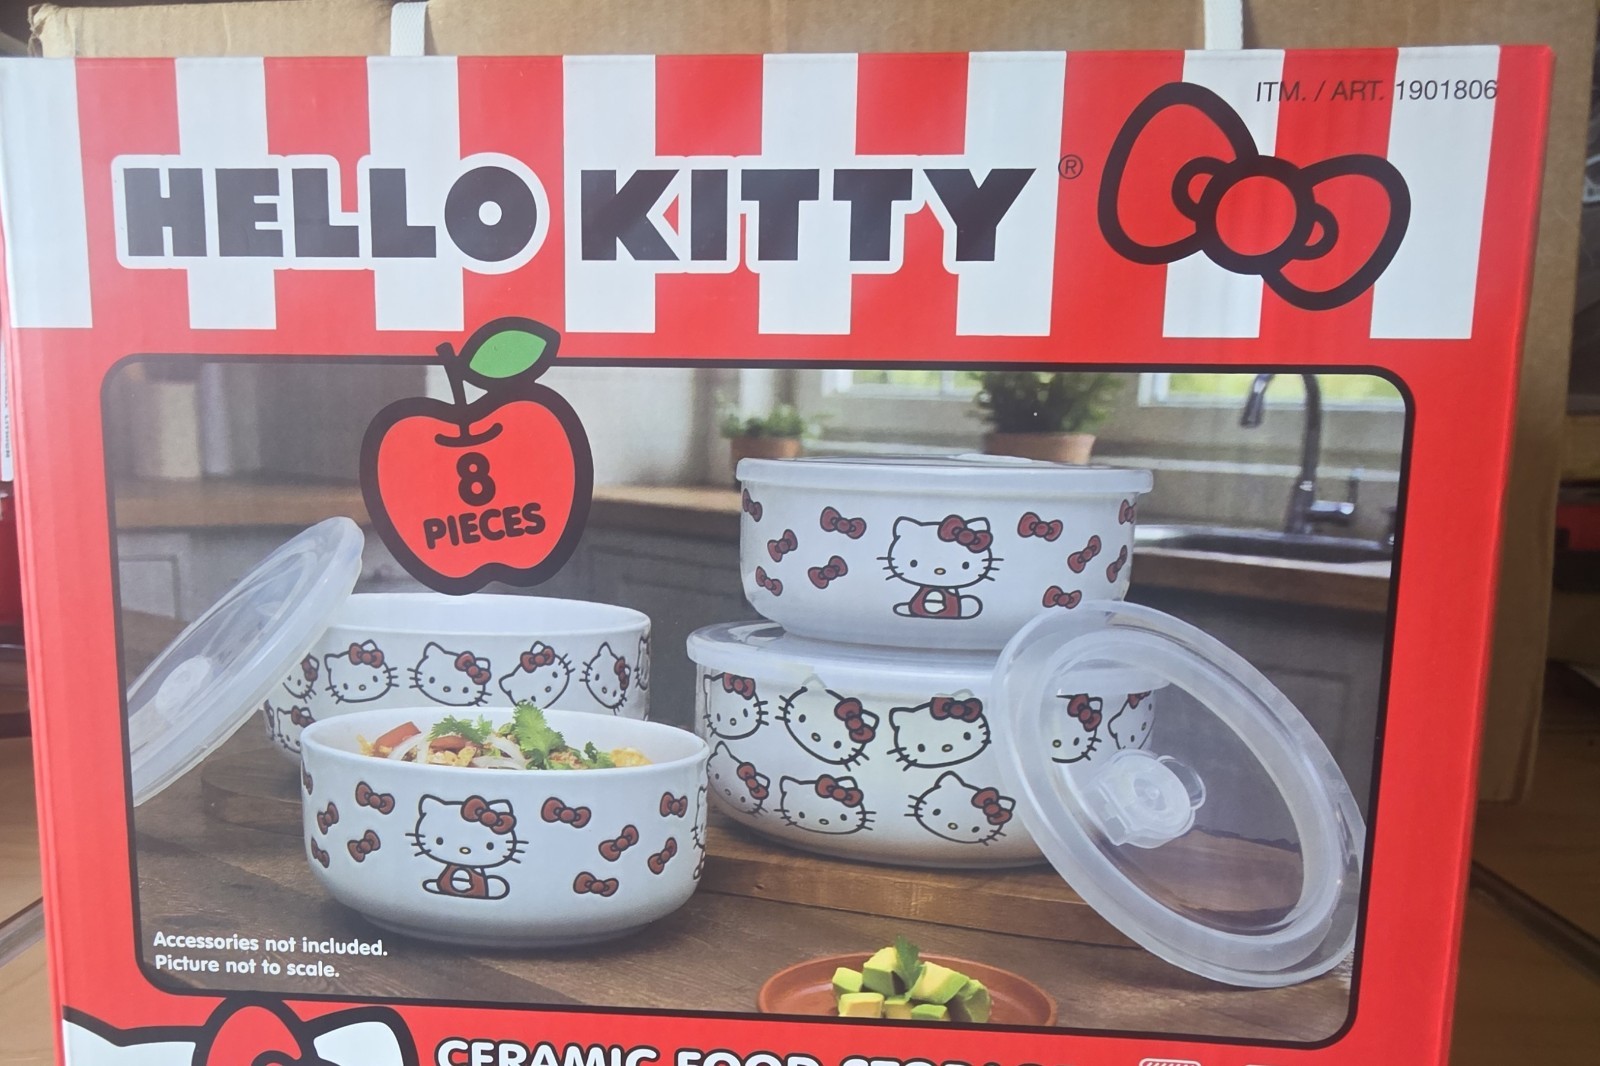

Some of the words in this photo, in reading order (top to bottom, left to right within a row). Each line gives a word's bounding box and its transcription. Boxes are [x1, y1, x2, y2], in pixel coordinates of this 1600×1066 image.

[1256, 81, 1306, 102] ITM.
[1313, 81, 1326, 101] /
[1331, 80, 1384, 101] ART.
[1395, 79, 1499, 101] 1901806
[123, 165, 537, 262] HELLO
[581, 168, 1037, 262] KITTY
[456, 451, 496, 507] 8
[423, 502, 546, 550] PIECES
[153, 931, 259, 950] Accessories
[265, 937, 297, 952] not
[302, 937, 388, 956] included.
[155, 954, 220, 972] Picture
[225, 958, 257, 973] not
[261, 960, 281, 975] to
[286, 960, 340, 977] scale.
